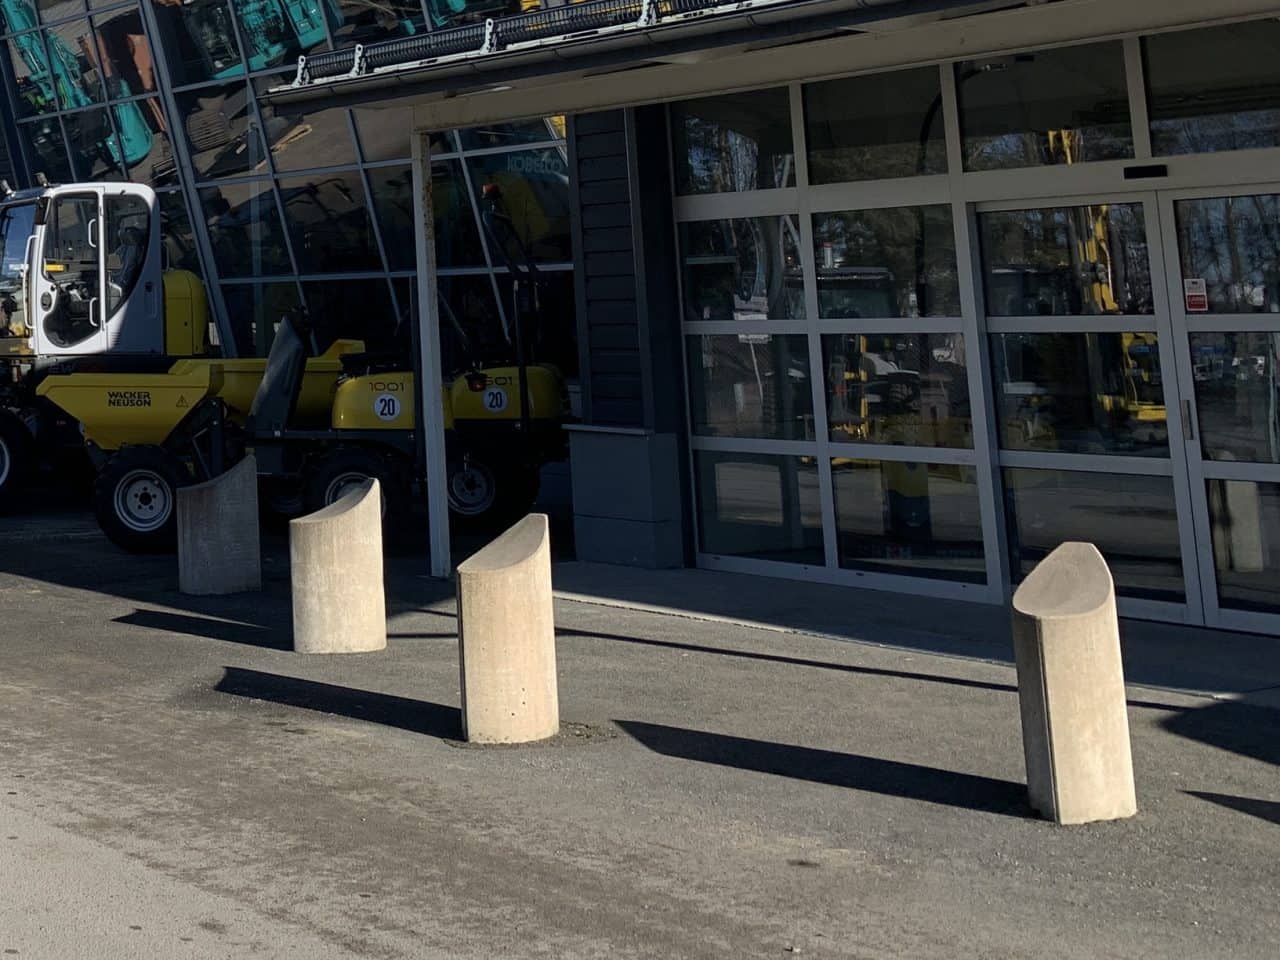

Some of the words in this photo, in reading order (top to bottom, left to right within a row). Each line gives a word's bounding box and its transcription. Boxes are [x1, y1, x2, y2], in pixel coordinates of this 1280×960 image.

[369, 382, 405, 392] 1001
[108, 391, 151, 400] WACKER
[488, 392, 503, 408] 20
[379, 398, 396, 416] 20
